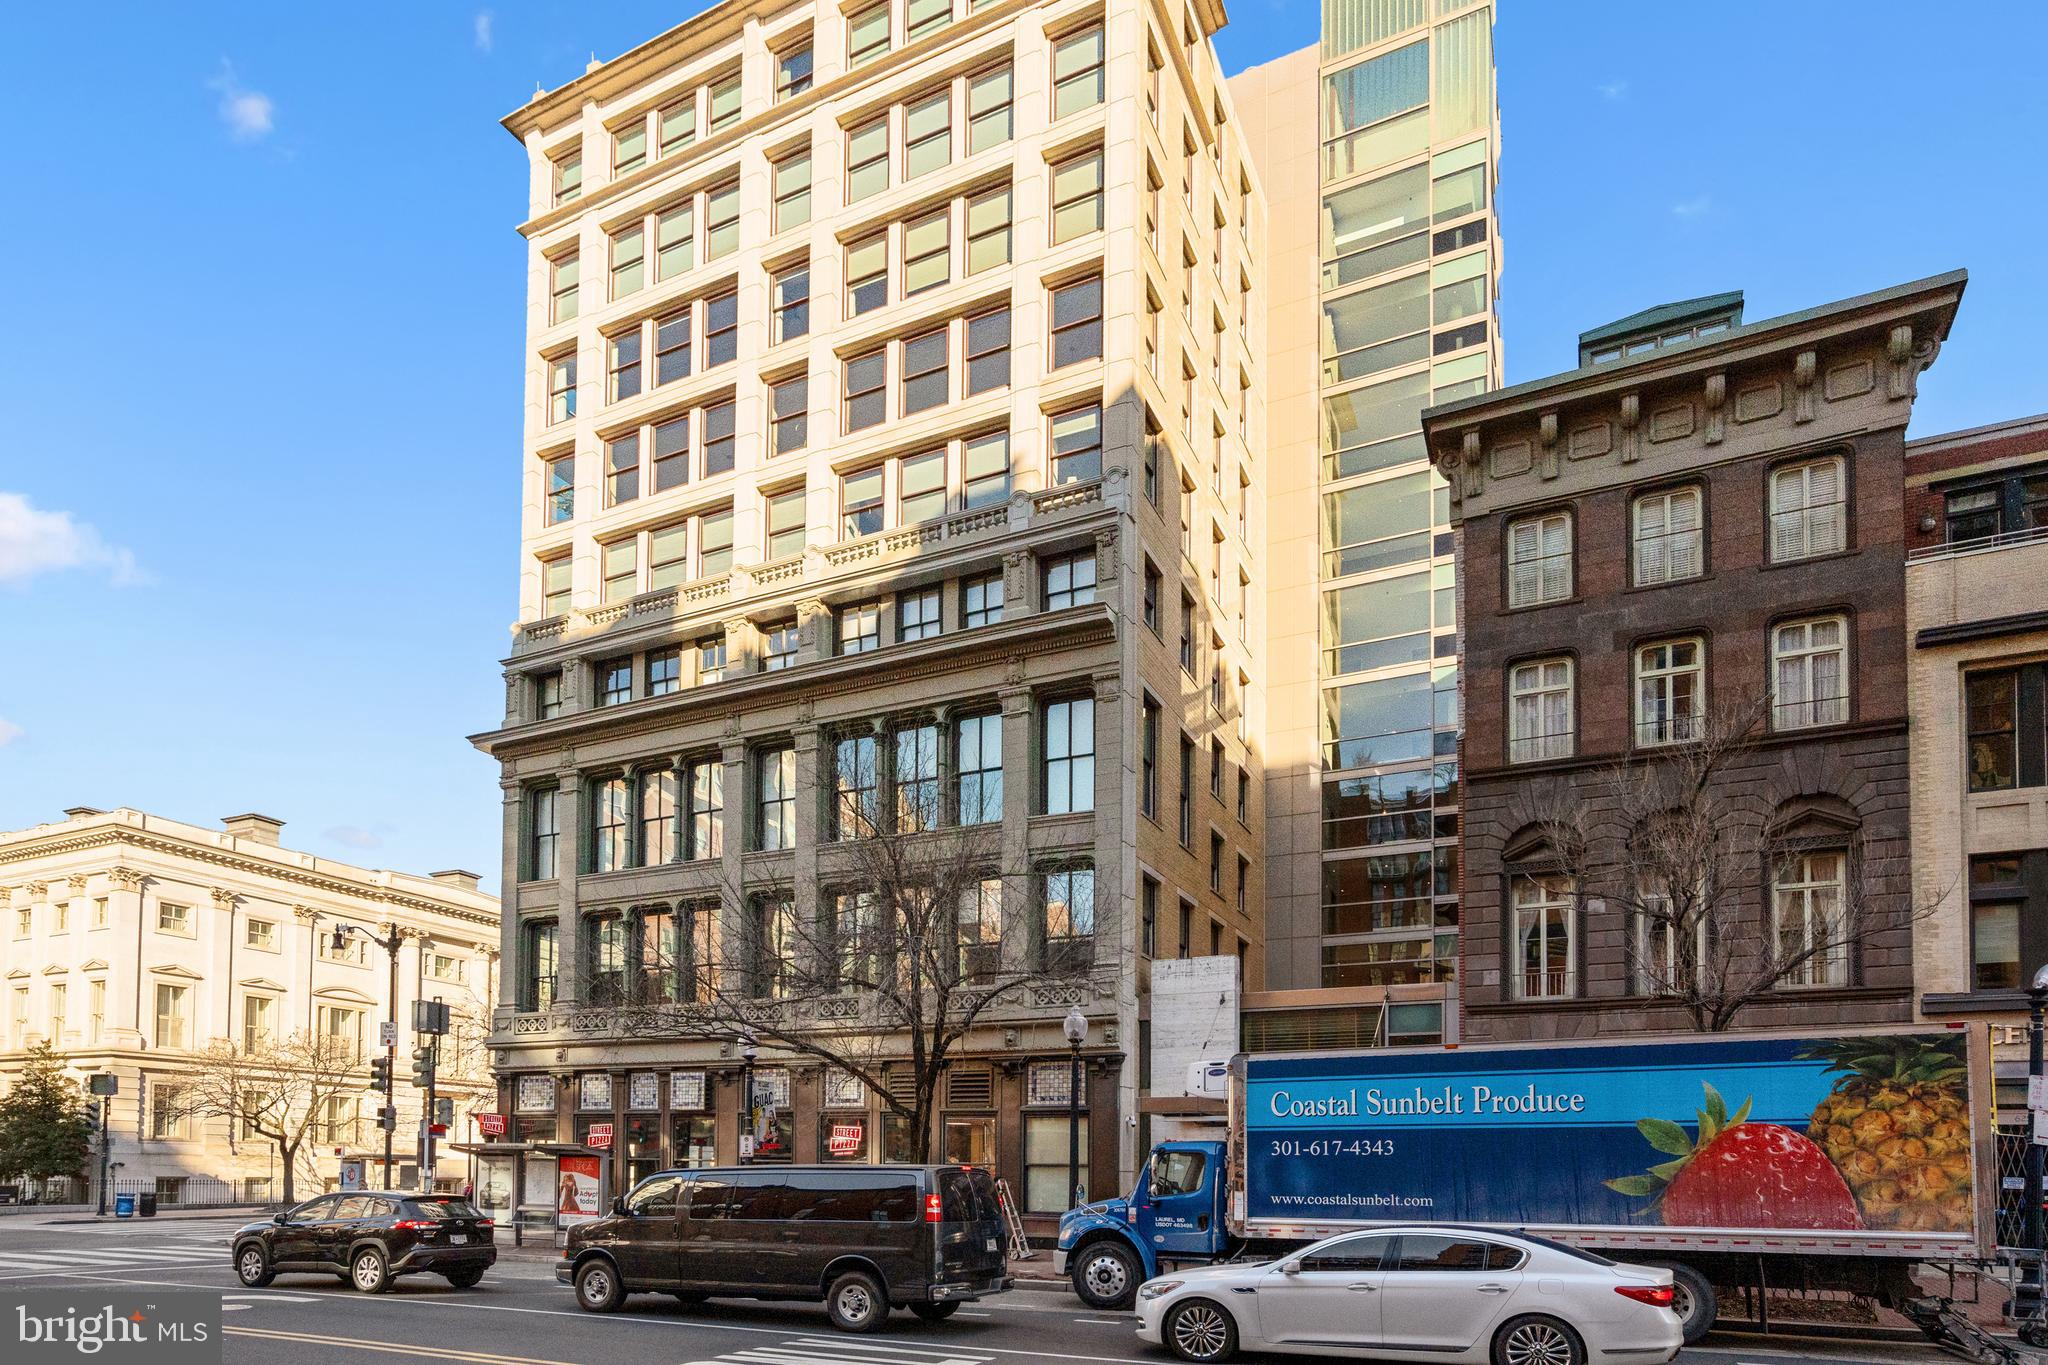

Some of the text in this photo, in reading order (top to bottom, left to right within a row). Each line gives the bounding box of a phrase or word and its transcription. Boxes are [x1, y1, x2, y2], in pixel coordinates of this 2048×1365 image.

[754, 1091, 774, 1108] GUAC
[1271, 1083, 1585, 1117] Coastal Sunbelt Produce
[591, 1125, 611, 1135] STREET
[836, 1128, 858, 1138] STREET
[591, 1136, 608, 1146] PIZZA
[833, 1140, 855, 1149] PIZZA
[1271, 1139, 1394, 1156] 301-617-4343
[1271, 1193, 1433, 1207] www.coastalsunbelt.com
